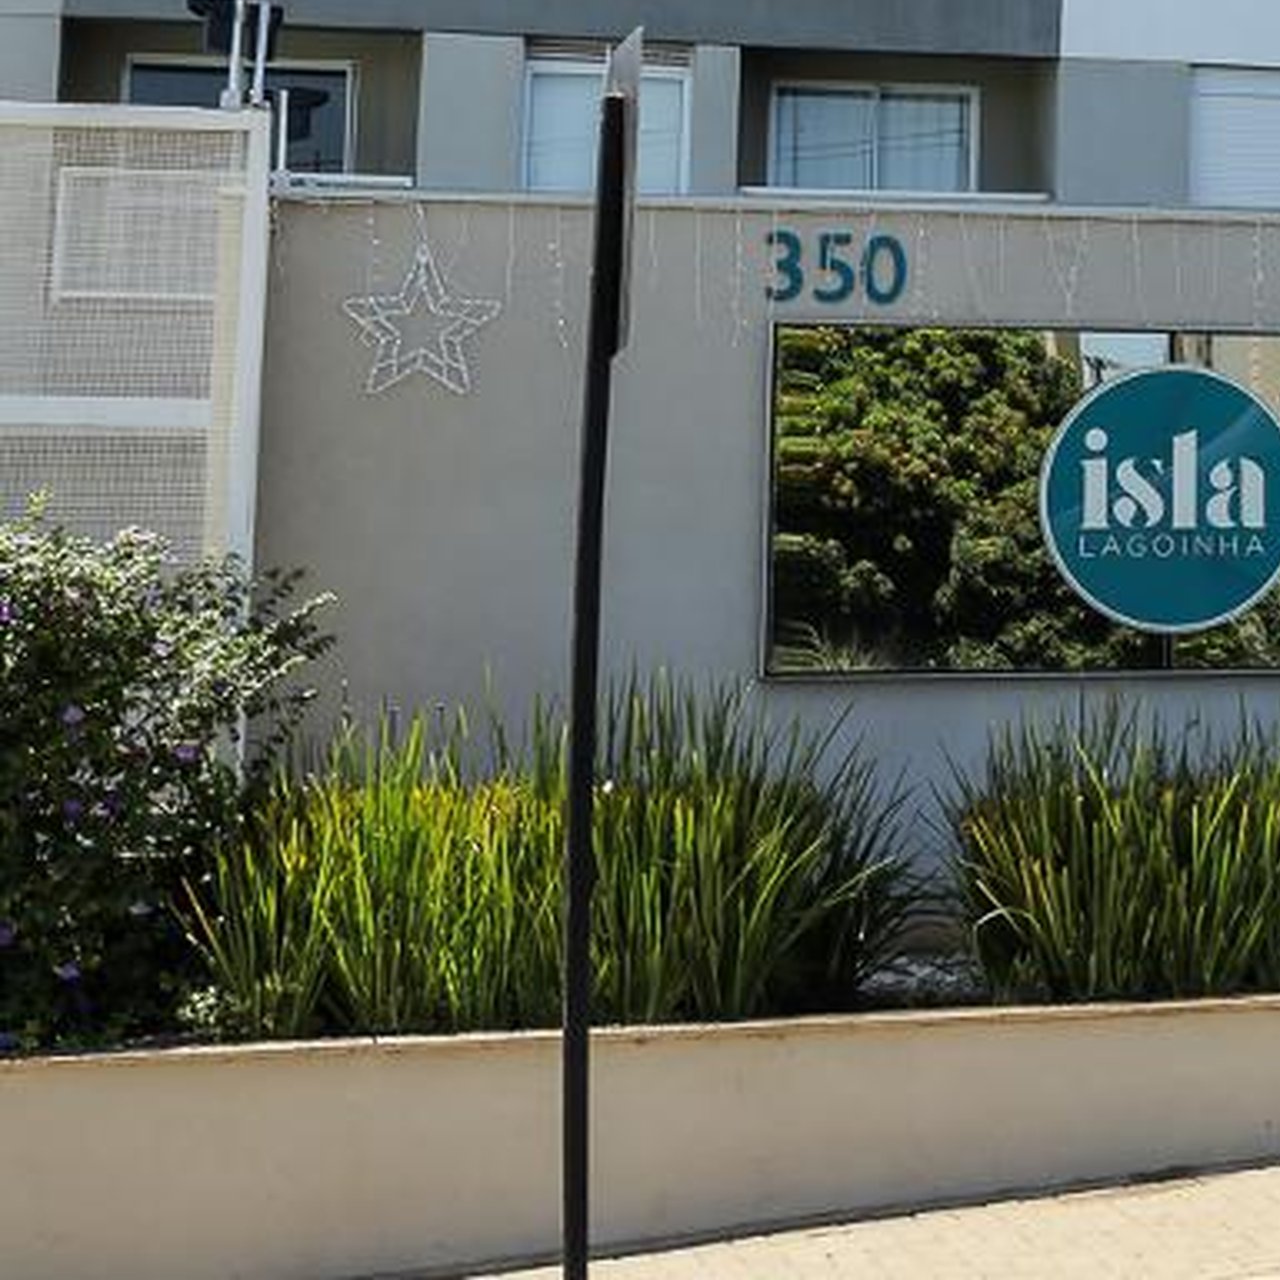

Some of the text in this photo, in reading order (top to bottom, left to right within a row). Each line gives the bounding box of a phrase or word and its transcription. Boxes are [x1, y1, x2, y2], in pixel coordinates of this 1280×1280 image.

[765, 230, 908, 305] 350
[1079, 428, 1265, 530] isla
[1079, 536, 1265, 558] LAGOINHA
